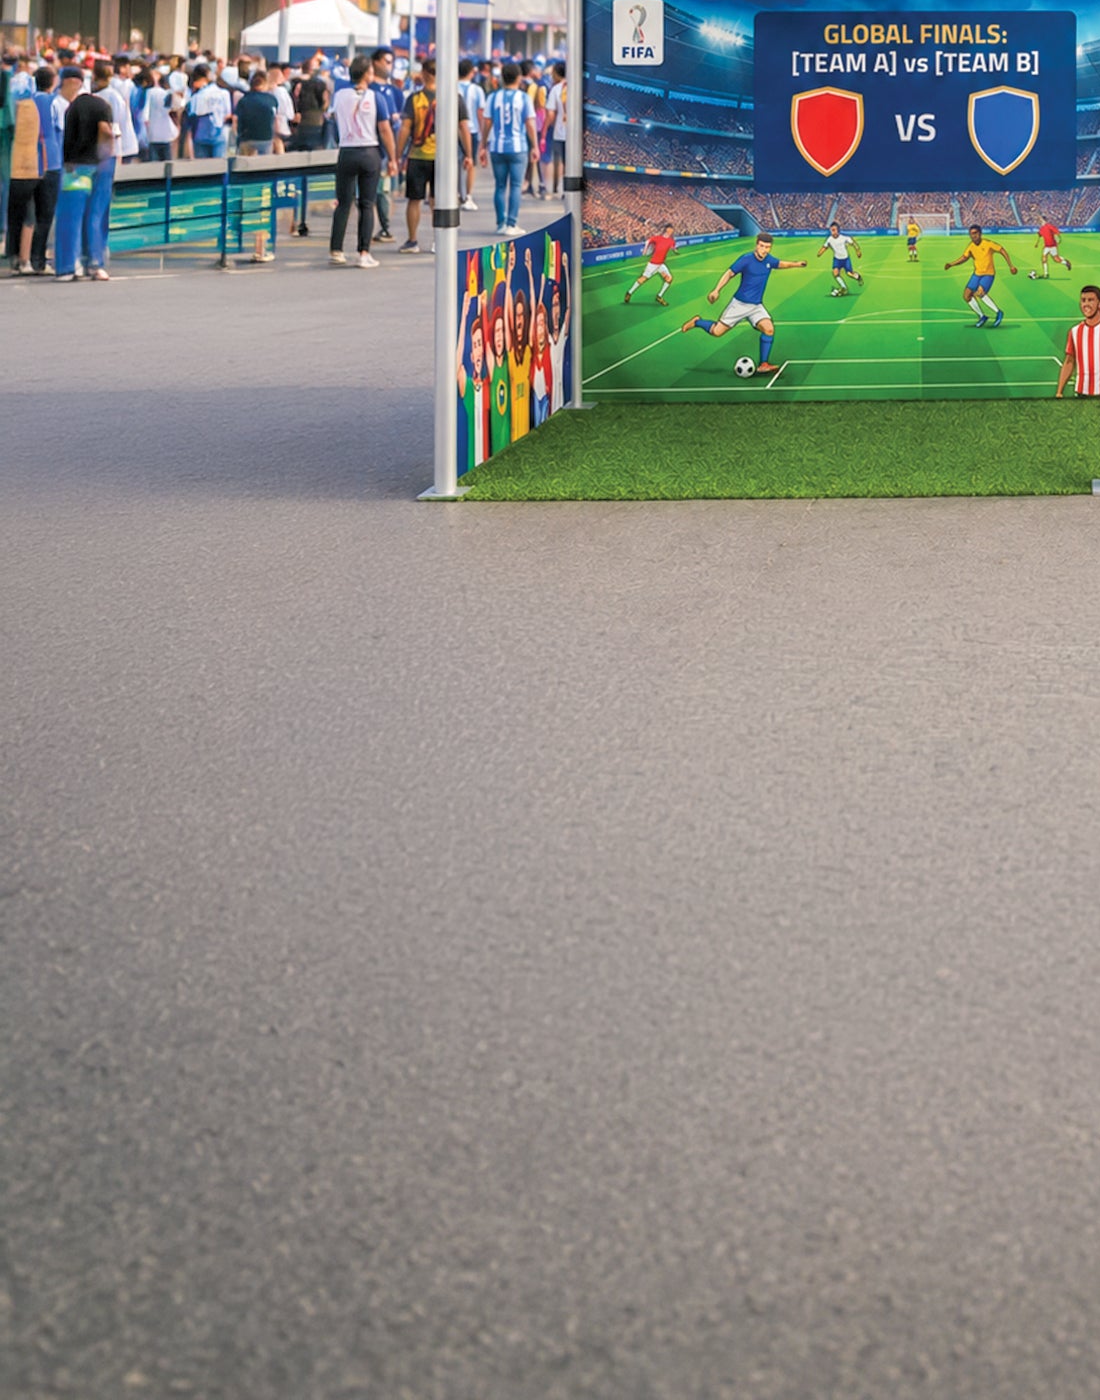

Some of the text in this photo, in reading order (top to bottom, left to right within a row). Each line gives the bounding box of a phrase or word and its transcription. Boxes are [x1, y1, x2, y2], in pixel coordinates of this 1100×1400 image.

[824, 23, 1008, 44] GLOBAL FINALS:
[621, 46, 655, 59] FIFA
[792, 50, 1039, 77] [TEAM A] vs [TEAM B]
[895, 113, 936, 142] VS
